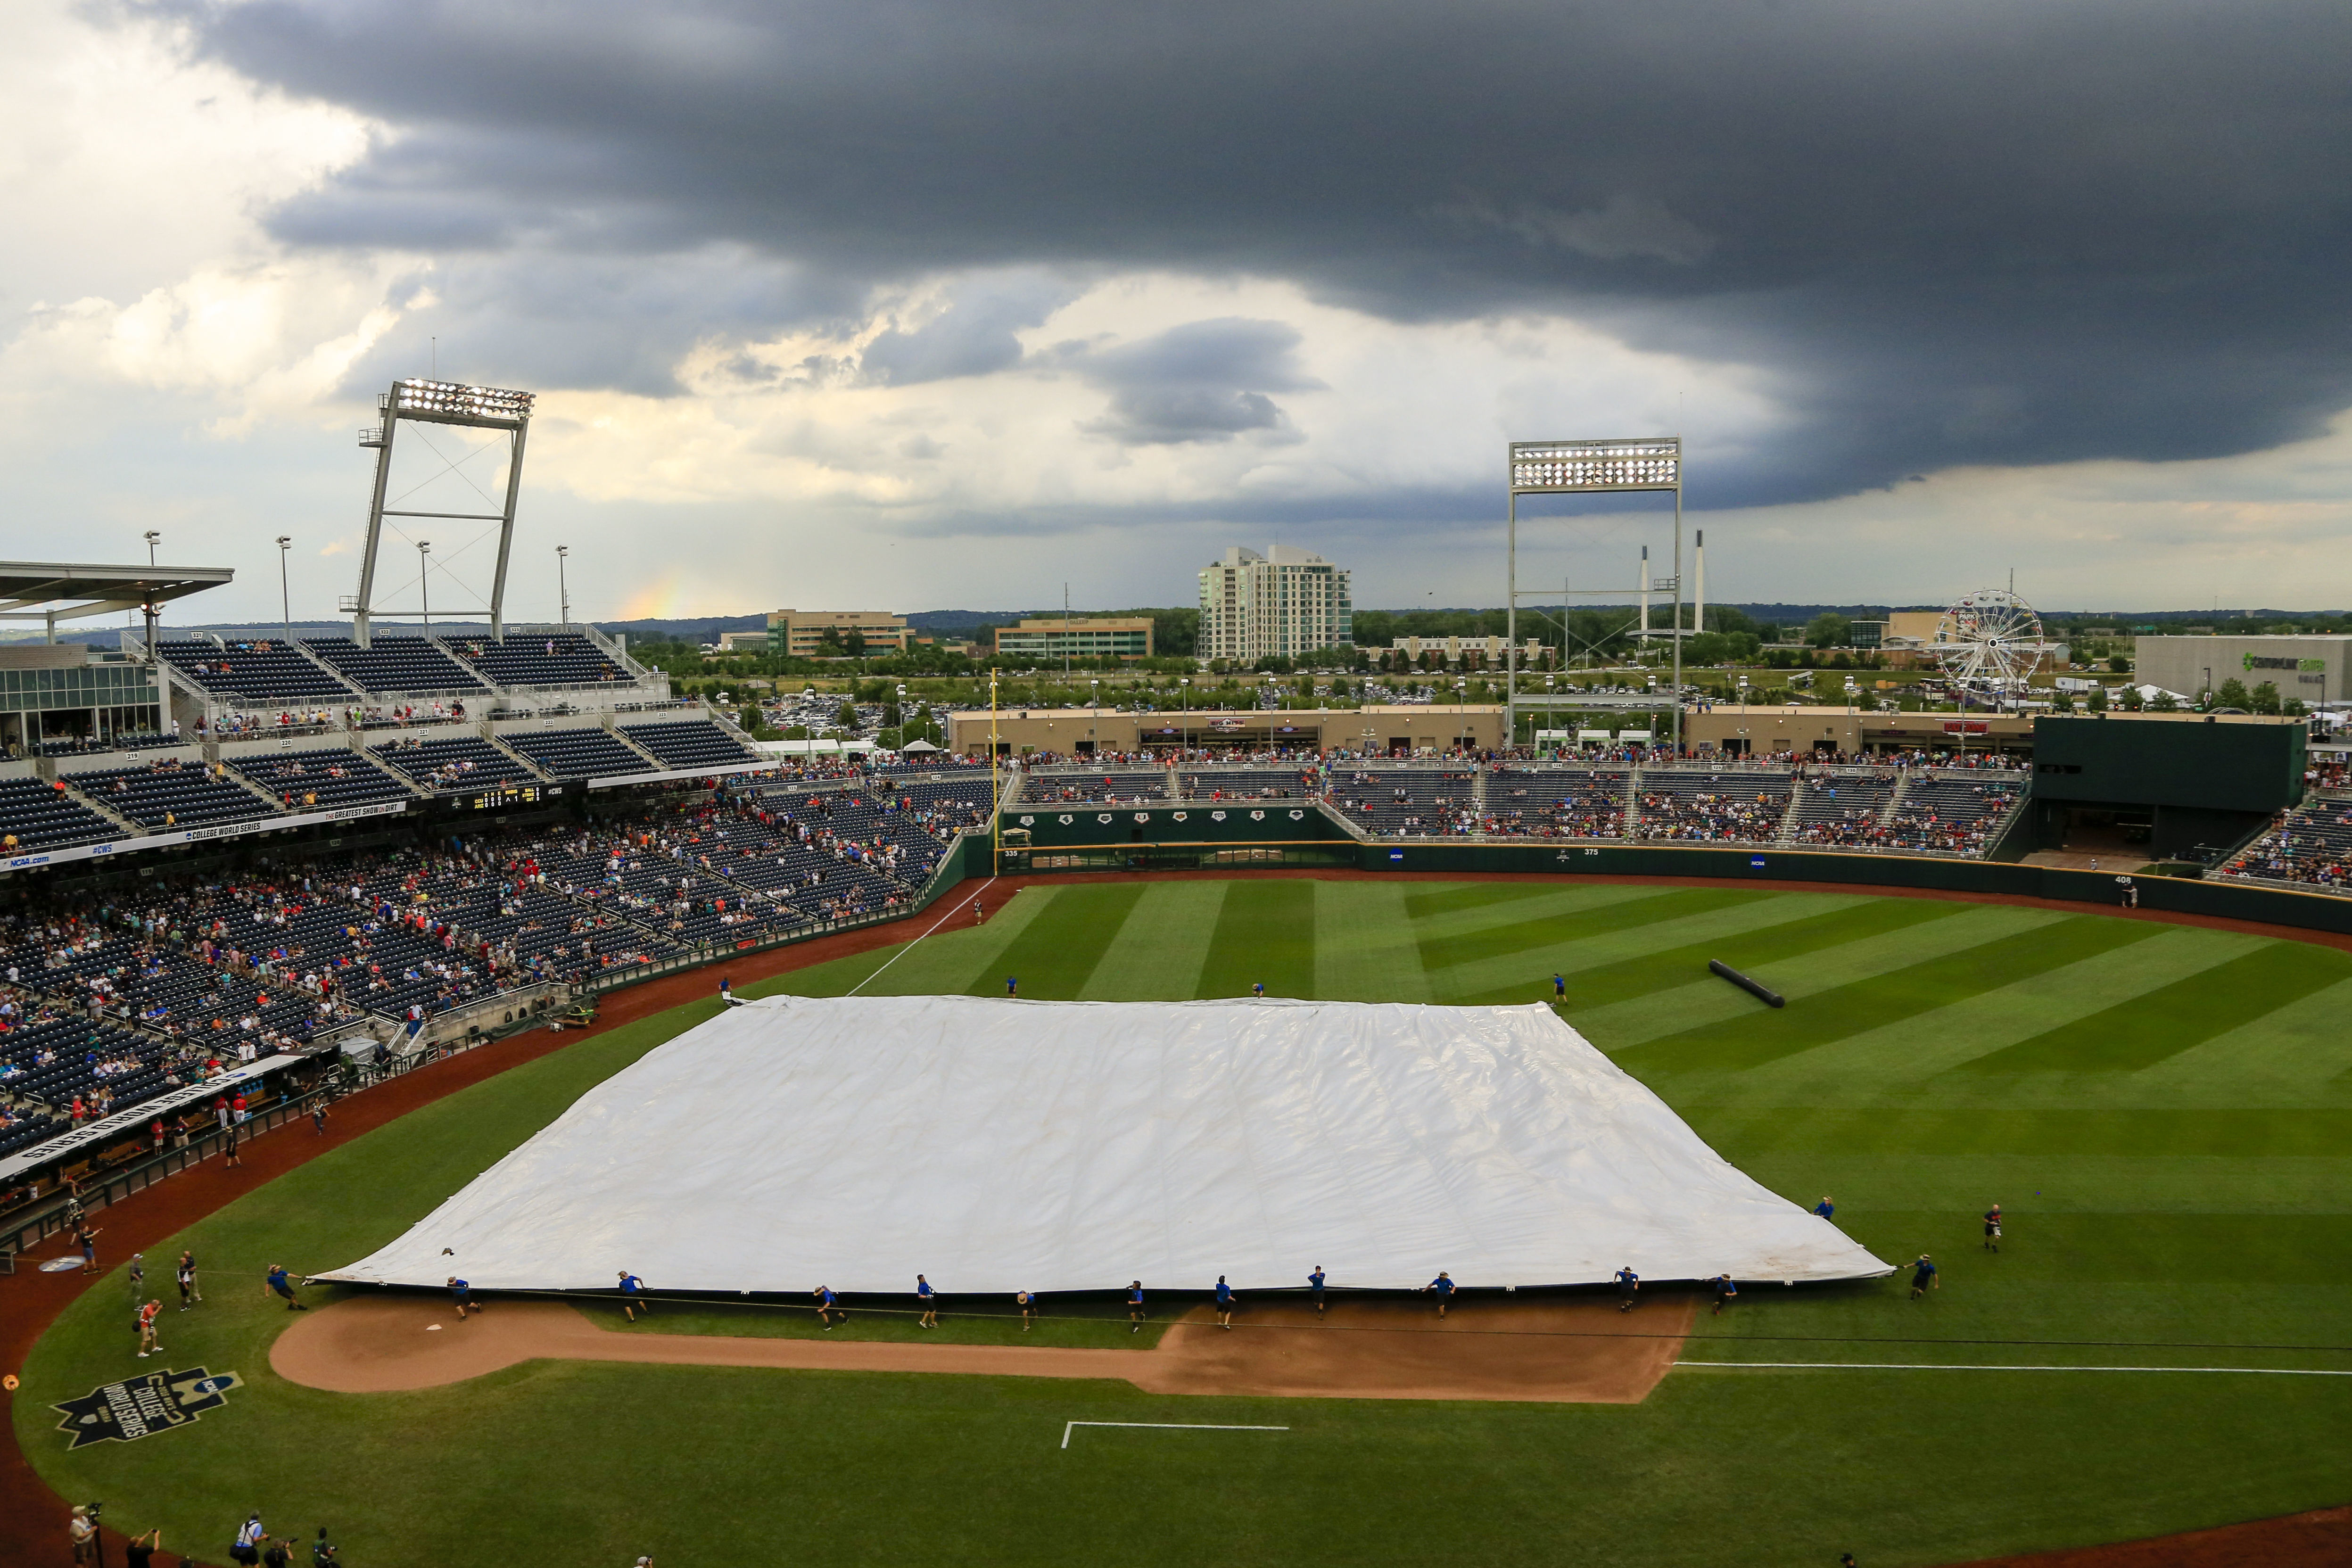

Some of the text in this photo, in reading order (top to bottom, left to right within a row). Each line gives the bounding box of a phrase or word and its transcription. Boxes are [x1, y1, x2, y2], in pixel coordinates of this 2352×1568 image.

[335, 809, 362, 819] GREATEST
[363, 806, 379, 815] SHOW
[385, 804, 397, 812] DIRT
[192, 823, 261, 839] COLLEGE WORLD SERIES
[93, 844, 112, 854] #CWS
[10, 856, 49, 867] NCAA.com
[2115, 875, 2131, 884] 408
[157, 1078, 231, 1105] COLLEGE
[91, 1105, 163, 1130] WORLD
[22, 1130, 98, 1158] SERIES
[202, 1380, 219, 1394] NCAA
[103, 1383, 149, 1437] WORLD SERIES
[132, 1386, 168, 1420] COLLEGE
